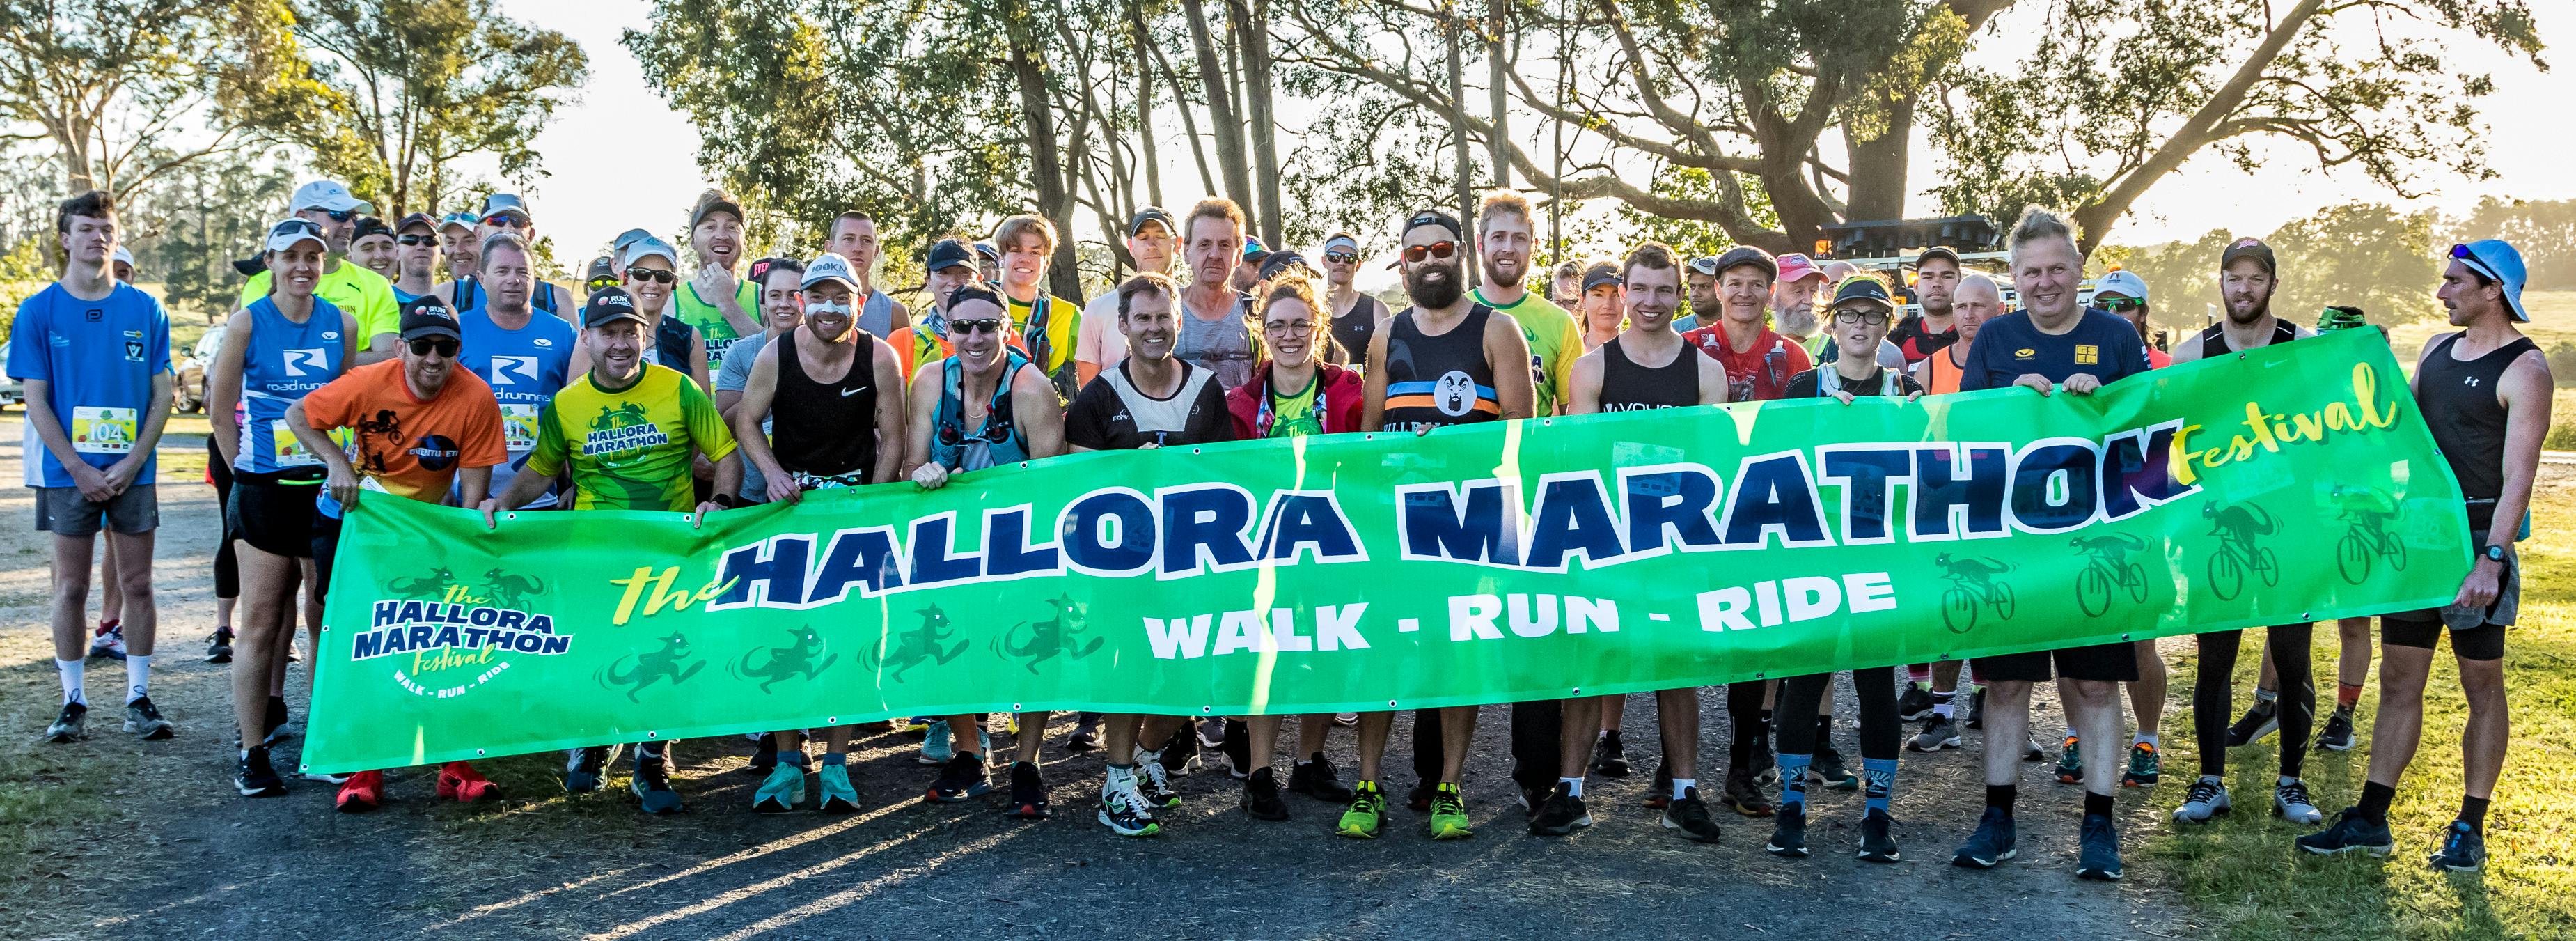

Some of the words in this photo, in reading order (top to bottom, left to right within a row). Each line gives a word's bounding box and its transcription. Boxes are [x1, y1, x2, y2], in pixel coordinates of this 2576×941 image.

[704, 339, 741, 350] LLO
[88, 422, 123, 441] 104
[582, 433, 669, 456] MARATHON
[587, 423, 658, 443] HALLORA
[610, 566, 740, 625] the
[705, 481, 1371, 612] HALLORA
[1395, 417, 2204, 574] MARATHON
[2169, 361, 2397, 486] Festival
[443, 584, 490, 605] the
[372, 600, 556, 636] HALLORA
[1143, 602, 1371, 660] WALK
[1448, 593, 1620, 641] RUN
[1696, 572, 1897, 632] RIDE
[350, 625, 573, 662] MARATHON
[412, 643, 496, 676] Festival
[393, 669, 425, 696] WALK
[437, 685, 466, 699] RUN
[478, 661, 510, 685] RIDE
